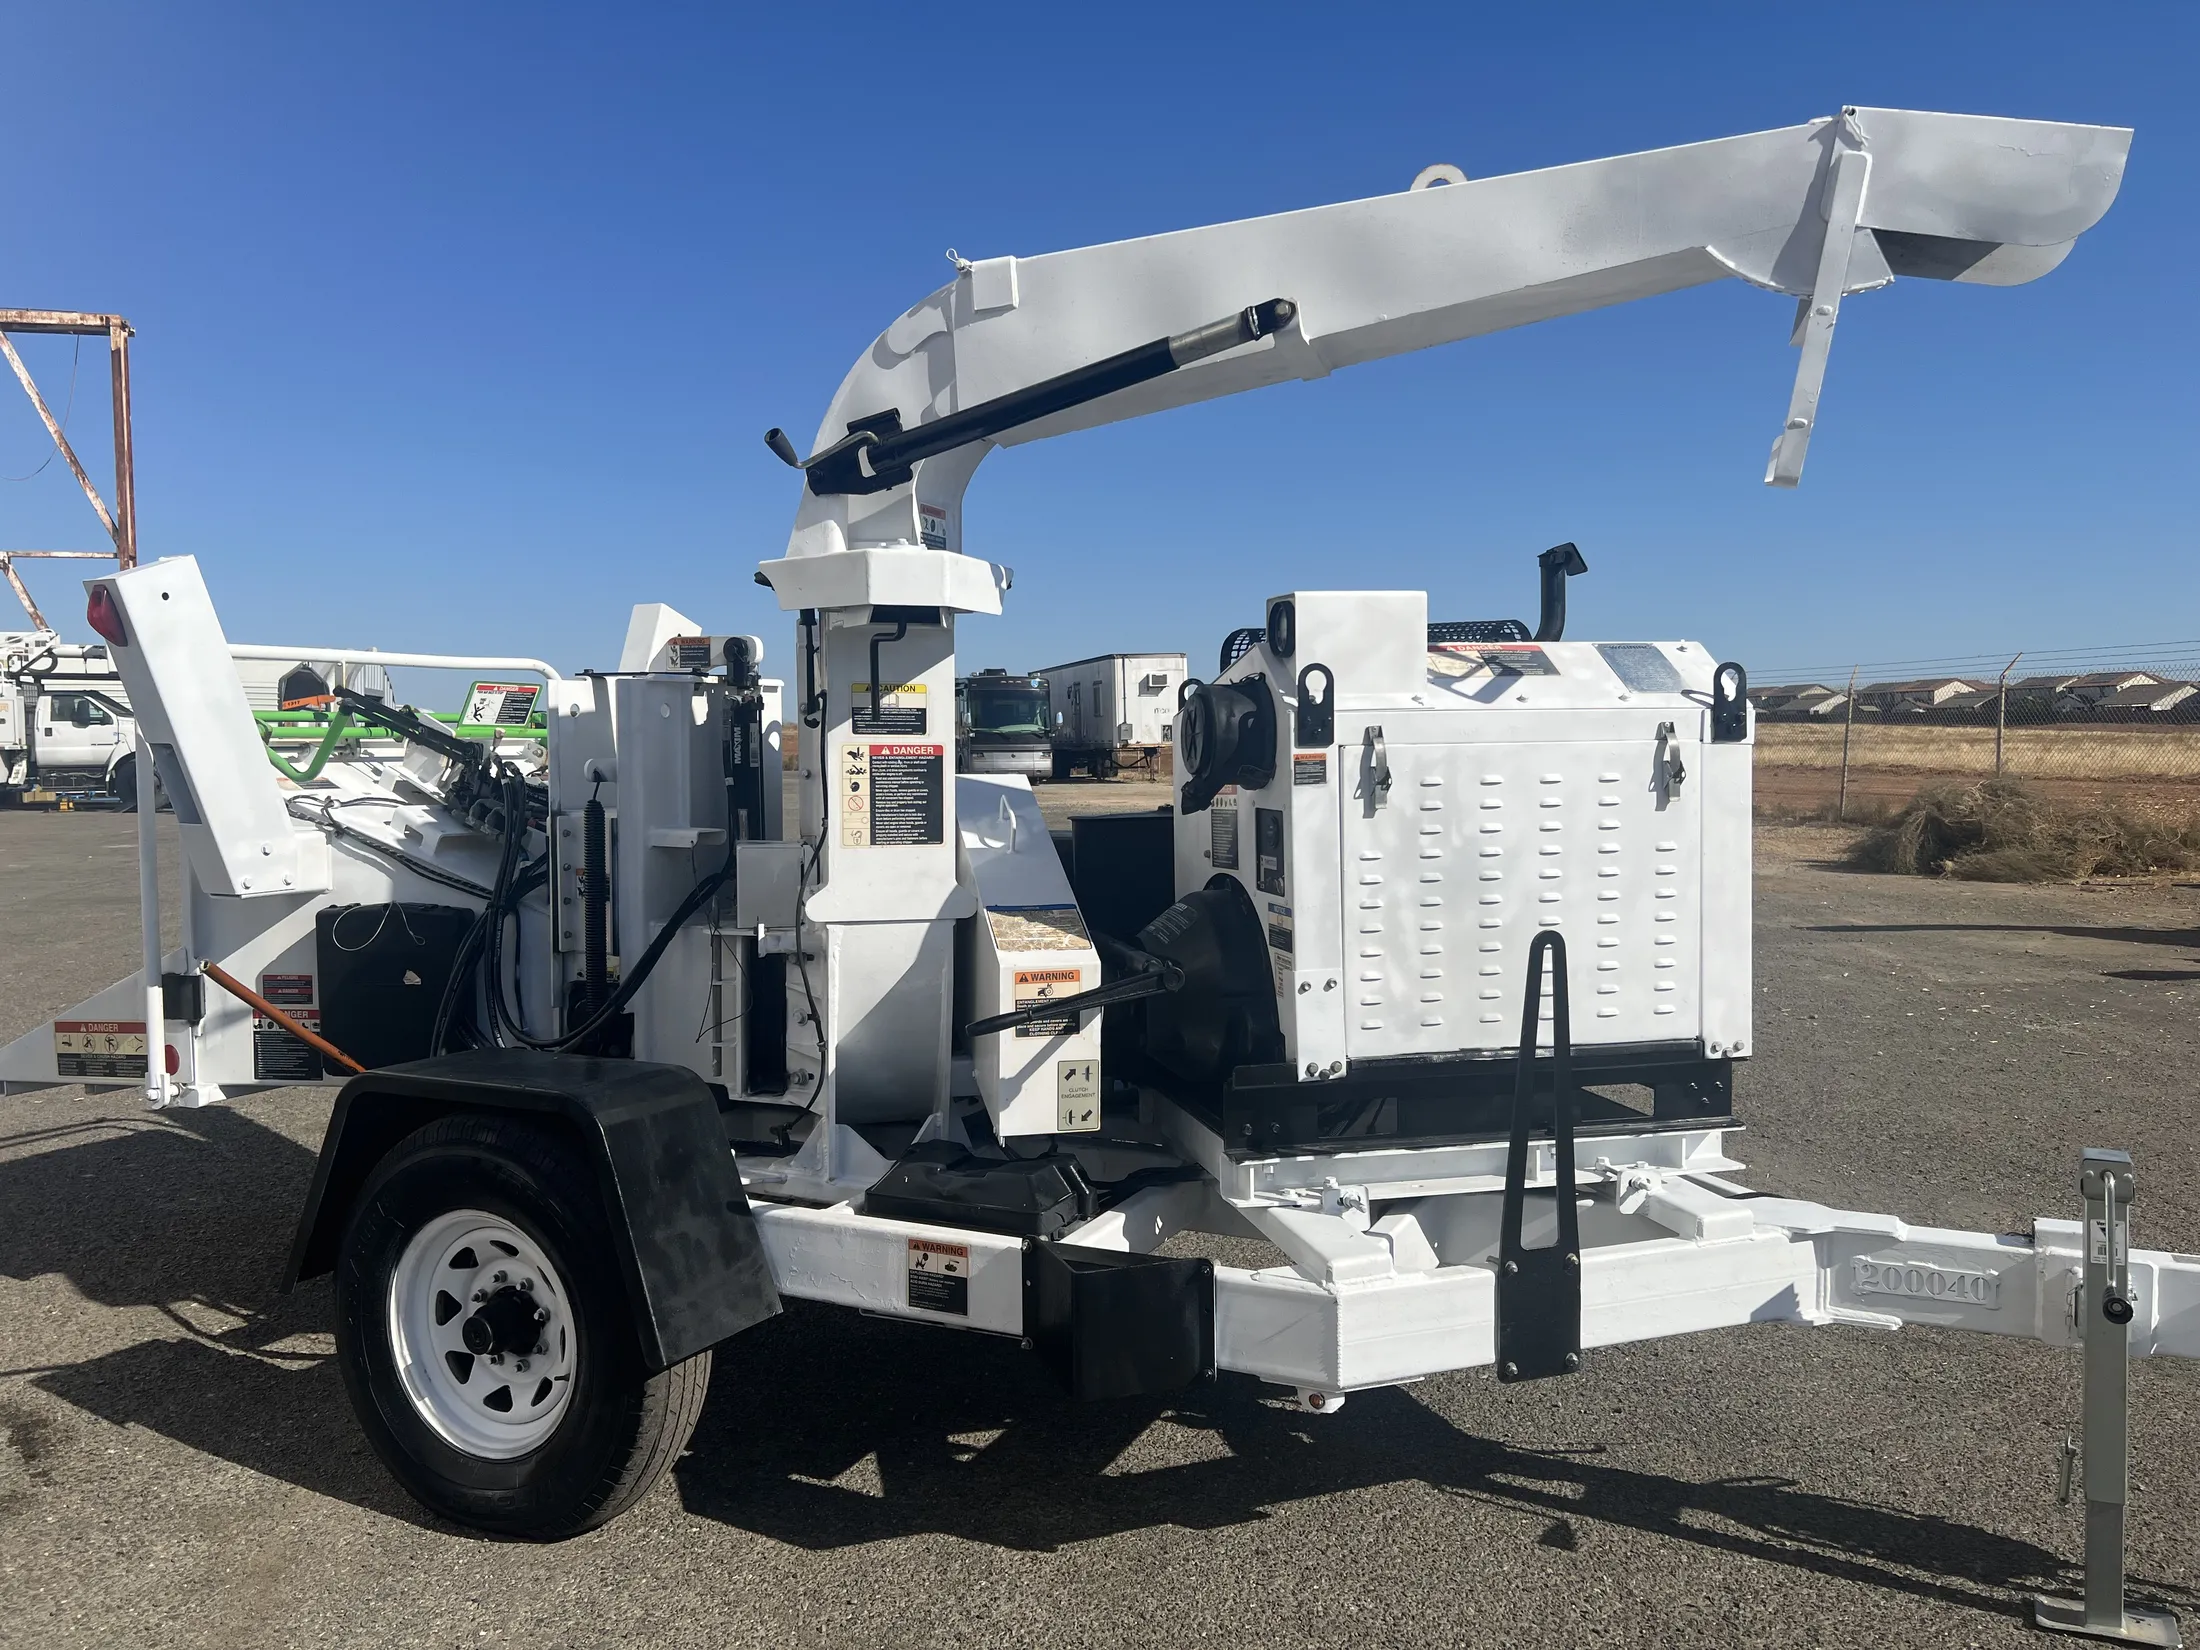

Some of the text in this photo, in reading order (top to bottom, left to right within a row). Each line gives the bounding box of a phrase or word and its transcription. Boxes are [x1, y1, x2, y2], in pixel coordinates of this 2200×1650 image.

[893, 746, 934, 755] DANGER
[1030, 972, 1075, 981] WARNING
[88, 1023, 119, 1032] DANGER
[921, 1242, 963, 1256] WARNING
